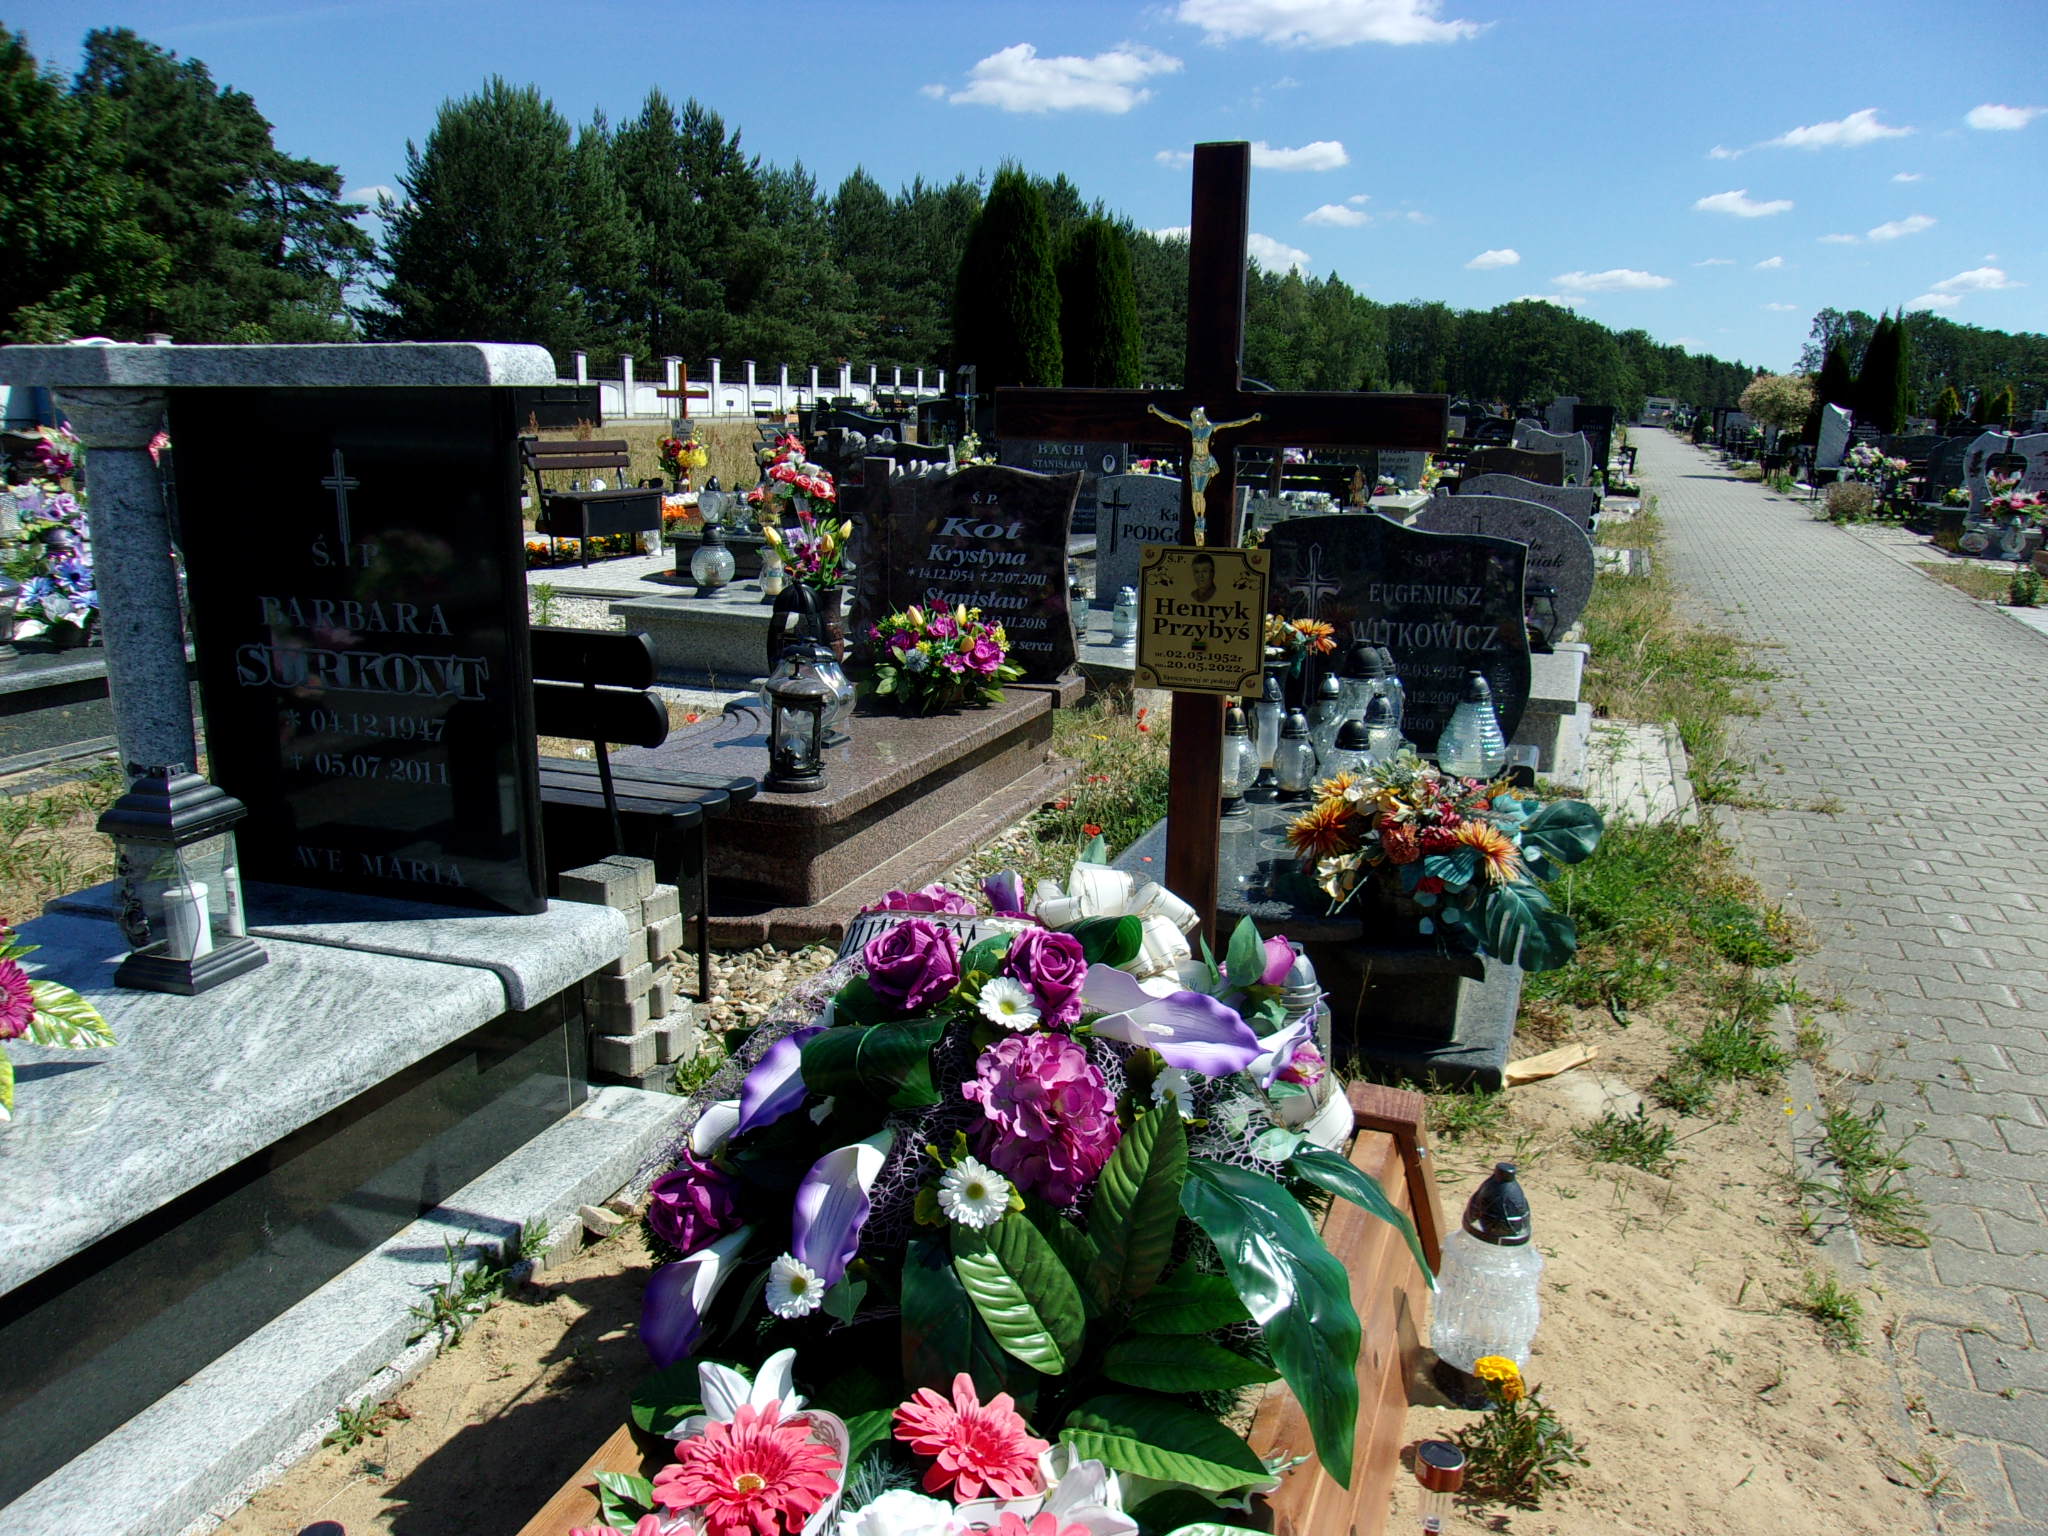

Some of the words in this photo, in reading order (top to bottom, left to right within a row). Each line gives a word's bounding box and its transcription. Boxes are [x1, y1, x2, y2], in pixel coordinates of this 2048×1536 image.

[936, 516, 1025, 540] Kot
[927, 544, 1028, 568] Krystyna
[918, 567, 976, 584] 14.12.1954
[987, 571, 1048, 586] 27.07.2011
[1369, 583, 1483, 606] EUGENIUSZ
[256, 594, 455, 637] BARBARA
[1154, 598, 1250, 623] Henryk
[1152, 617, 1250, 644] Przybyś
[1350, 618, 1499, 651] WITKOWICZ
[236, 641, 490, 702] SURKONT
[310, 709, 448, 742] 04.12.1947
[314, 753, 450, 786] 05.07.2011
[360, 852, 467, 888] MARIA
